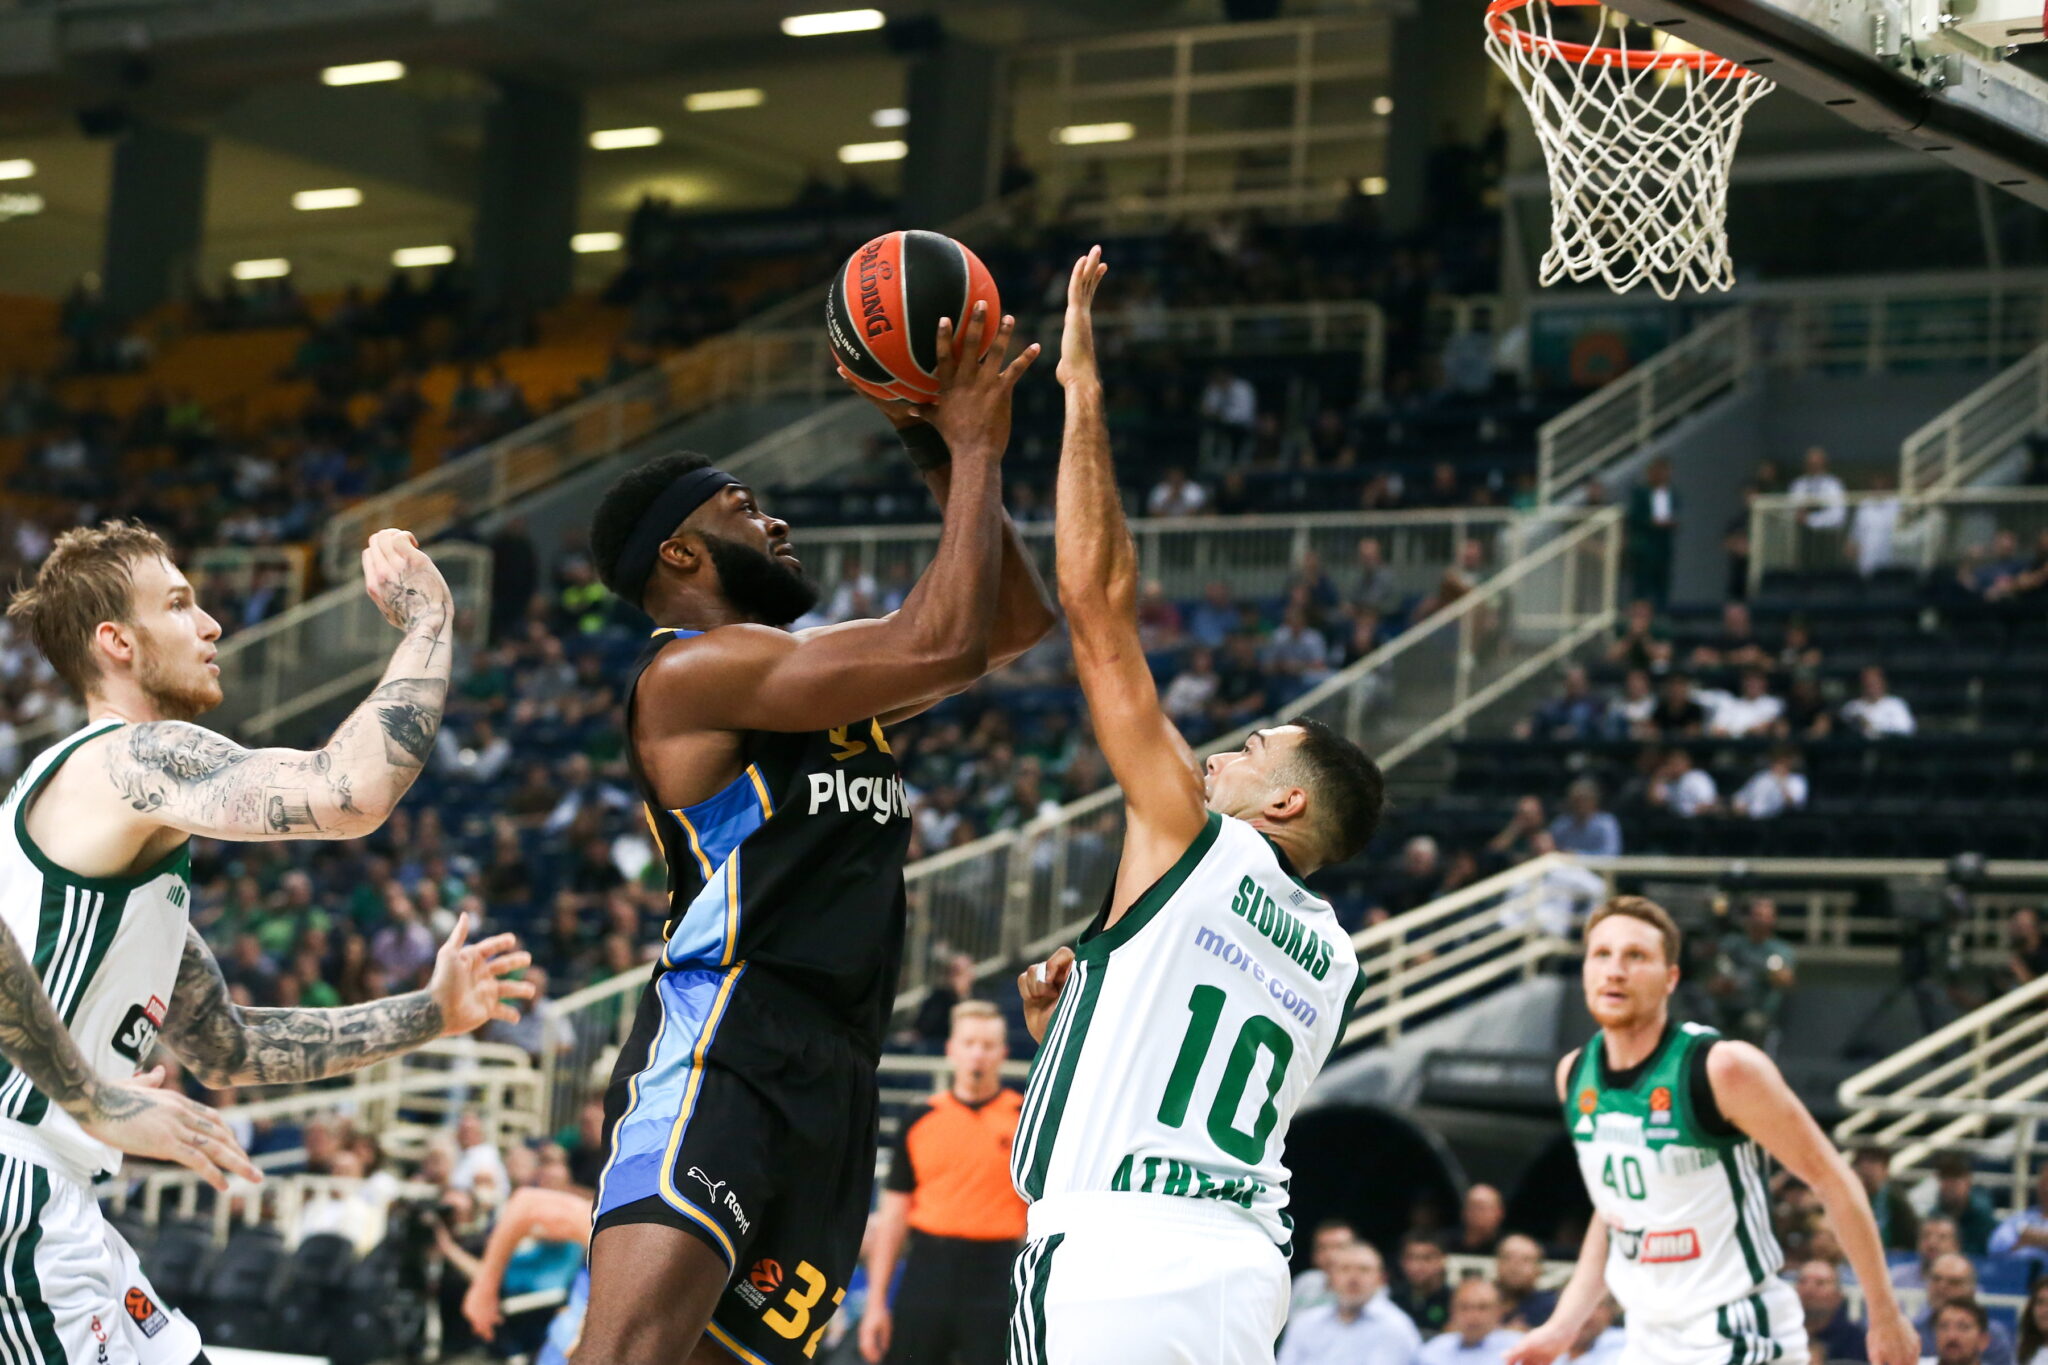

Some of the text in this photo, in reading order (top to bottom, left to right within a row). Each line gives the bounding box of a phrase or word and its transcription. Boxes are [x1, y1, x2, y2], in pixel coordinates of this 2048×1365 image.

[861, 237, 894, 337] PALDING
[831, 318, 861, 361] AIRLINES
[1194, 924, 1319, 1029] more.com
[1231, 874, 1335, 982] SLOUKAS
[1156, 984, 1295, 1167] 10
[723, 1190, 750, 1236] Rapyd
[1602, 1153, 1647, 1201] 40
